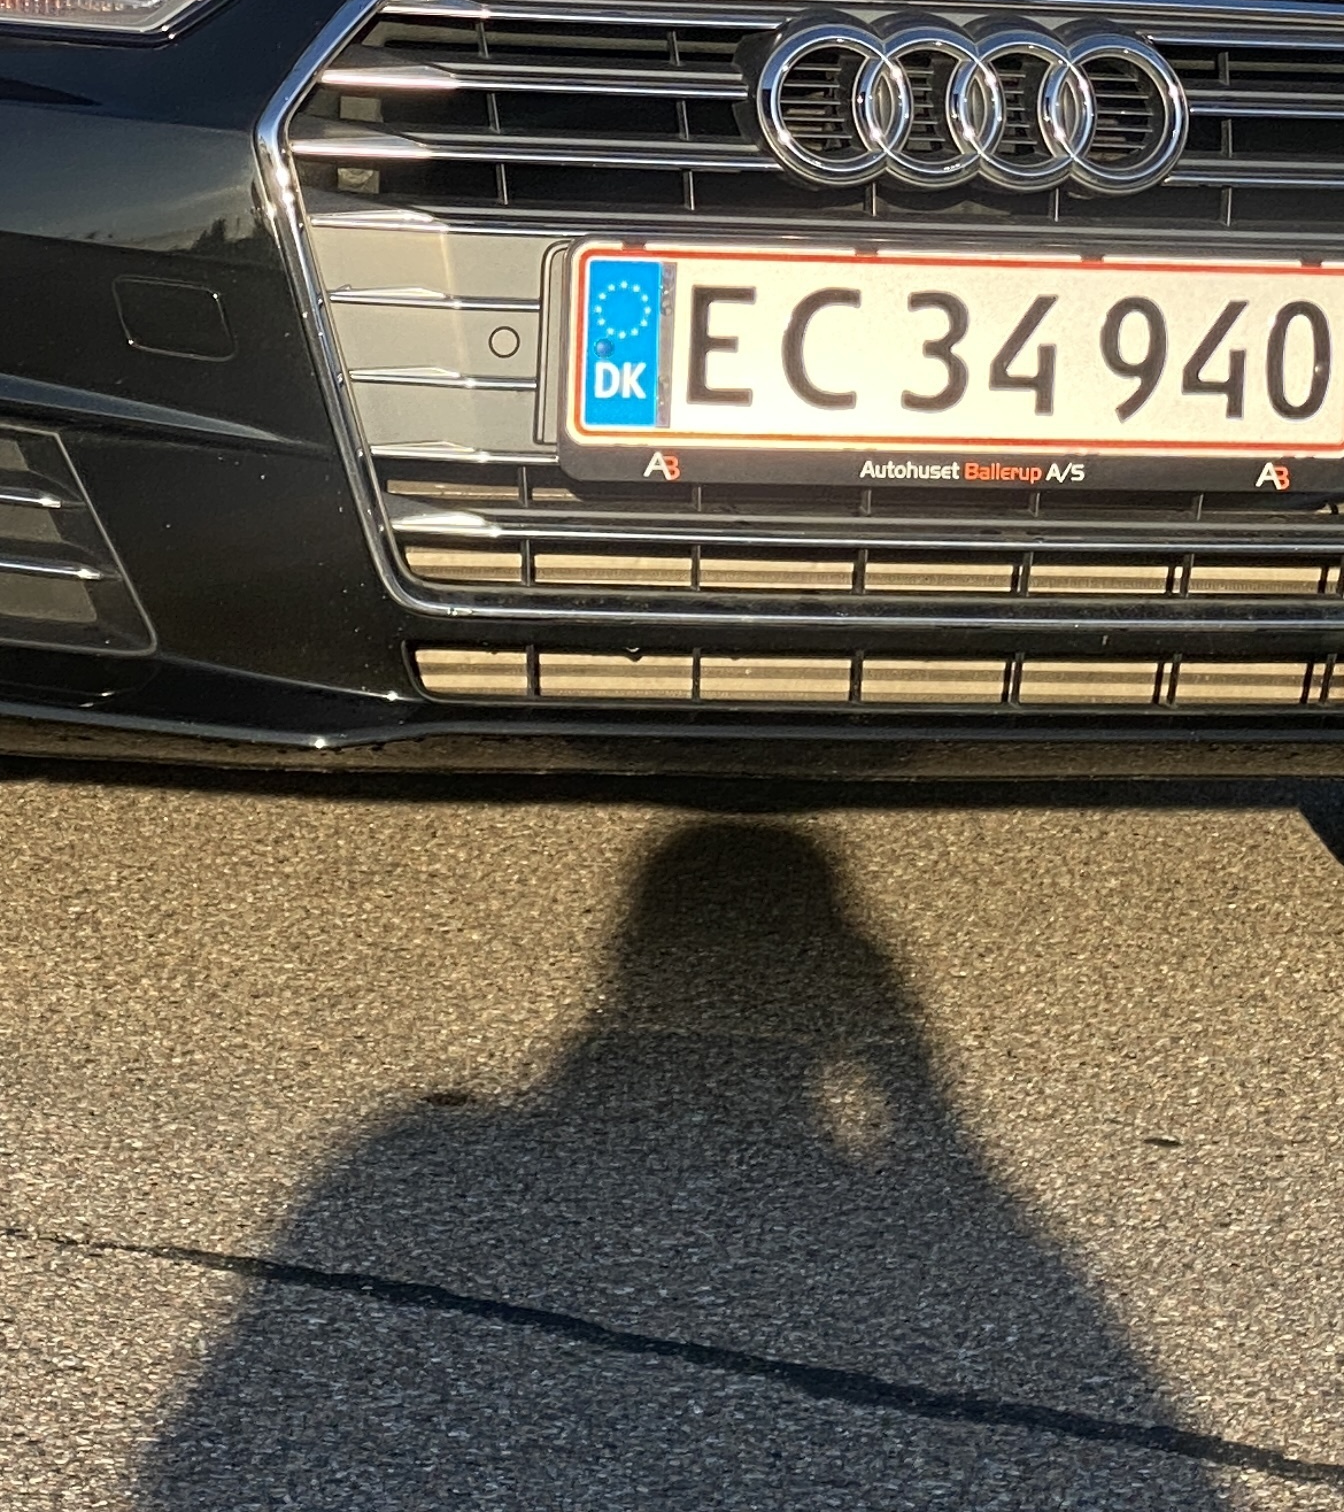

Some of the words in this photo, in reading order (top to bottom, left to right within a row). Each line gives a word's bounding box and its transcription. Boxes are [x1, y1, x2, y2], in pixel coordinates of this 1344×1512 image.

[687, 285, 862, 410] EC
[901, 291, 1058, 416] 34
[1099, 295, 1333, 422] 940
[594, 361, 647, 399] DK
[859, 460, 960, 480] Autohuset
[964, 462, 1043, 484] Ballerup
[1045, 462, 1086, 483] A/S
